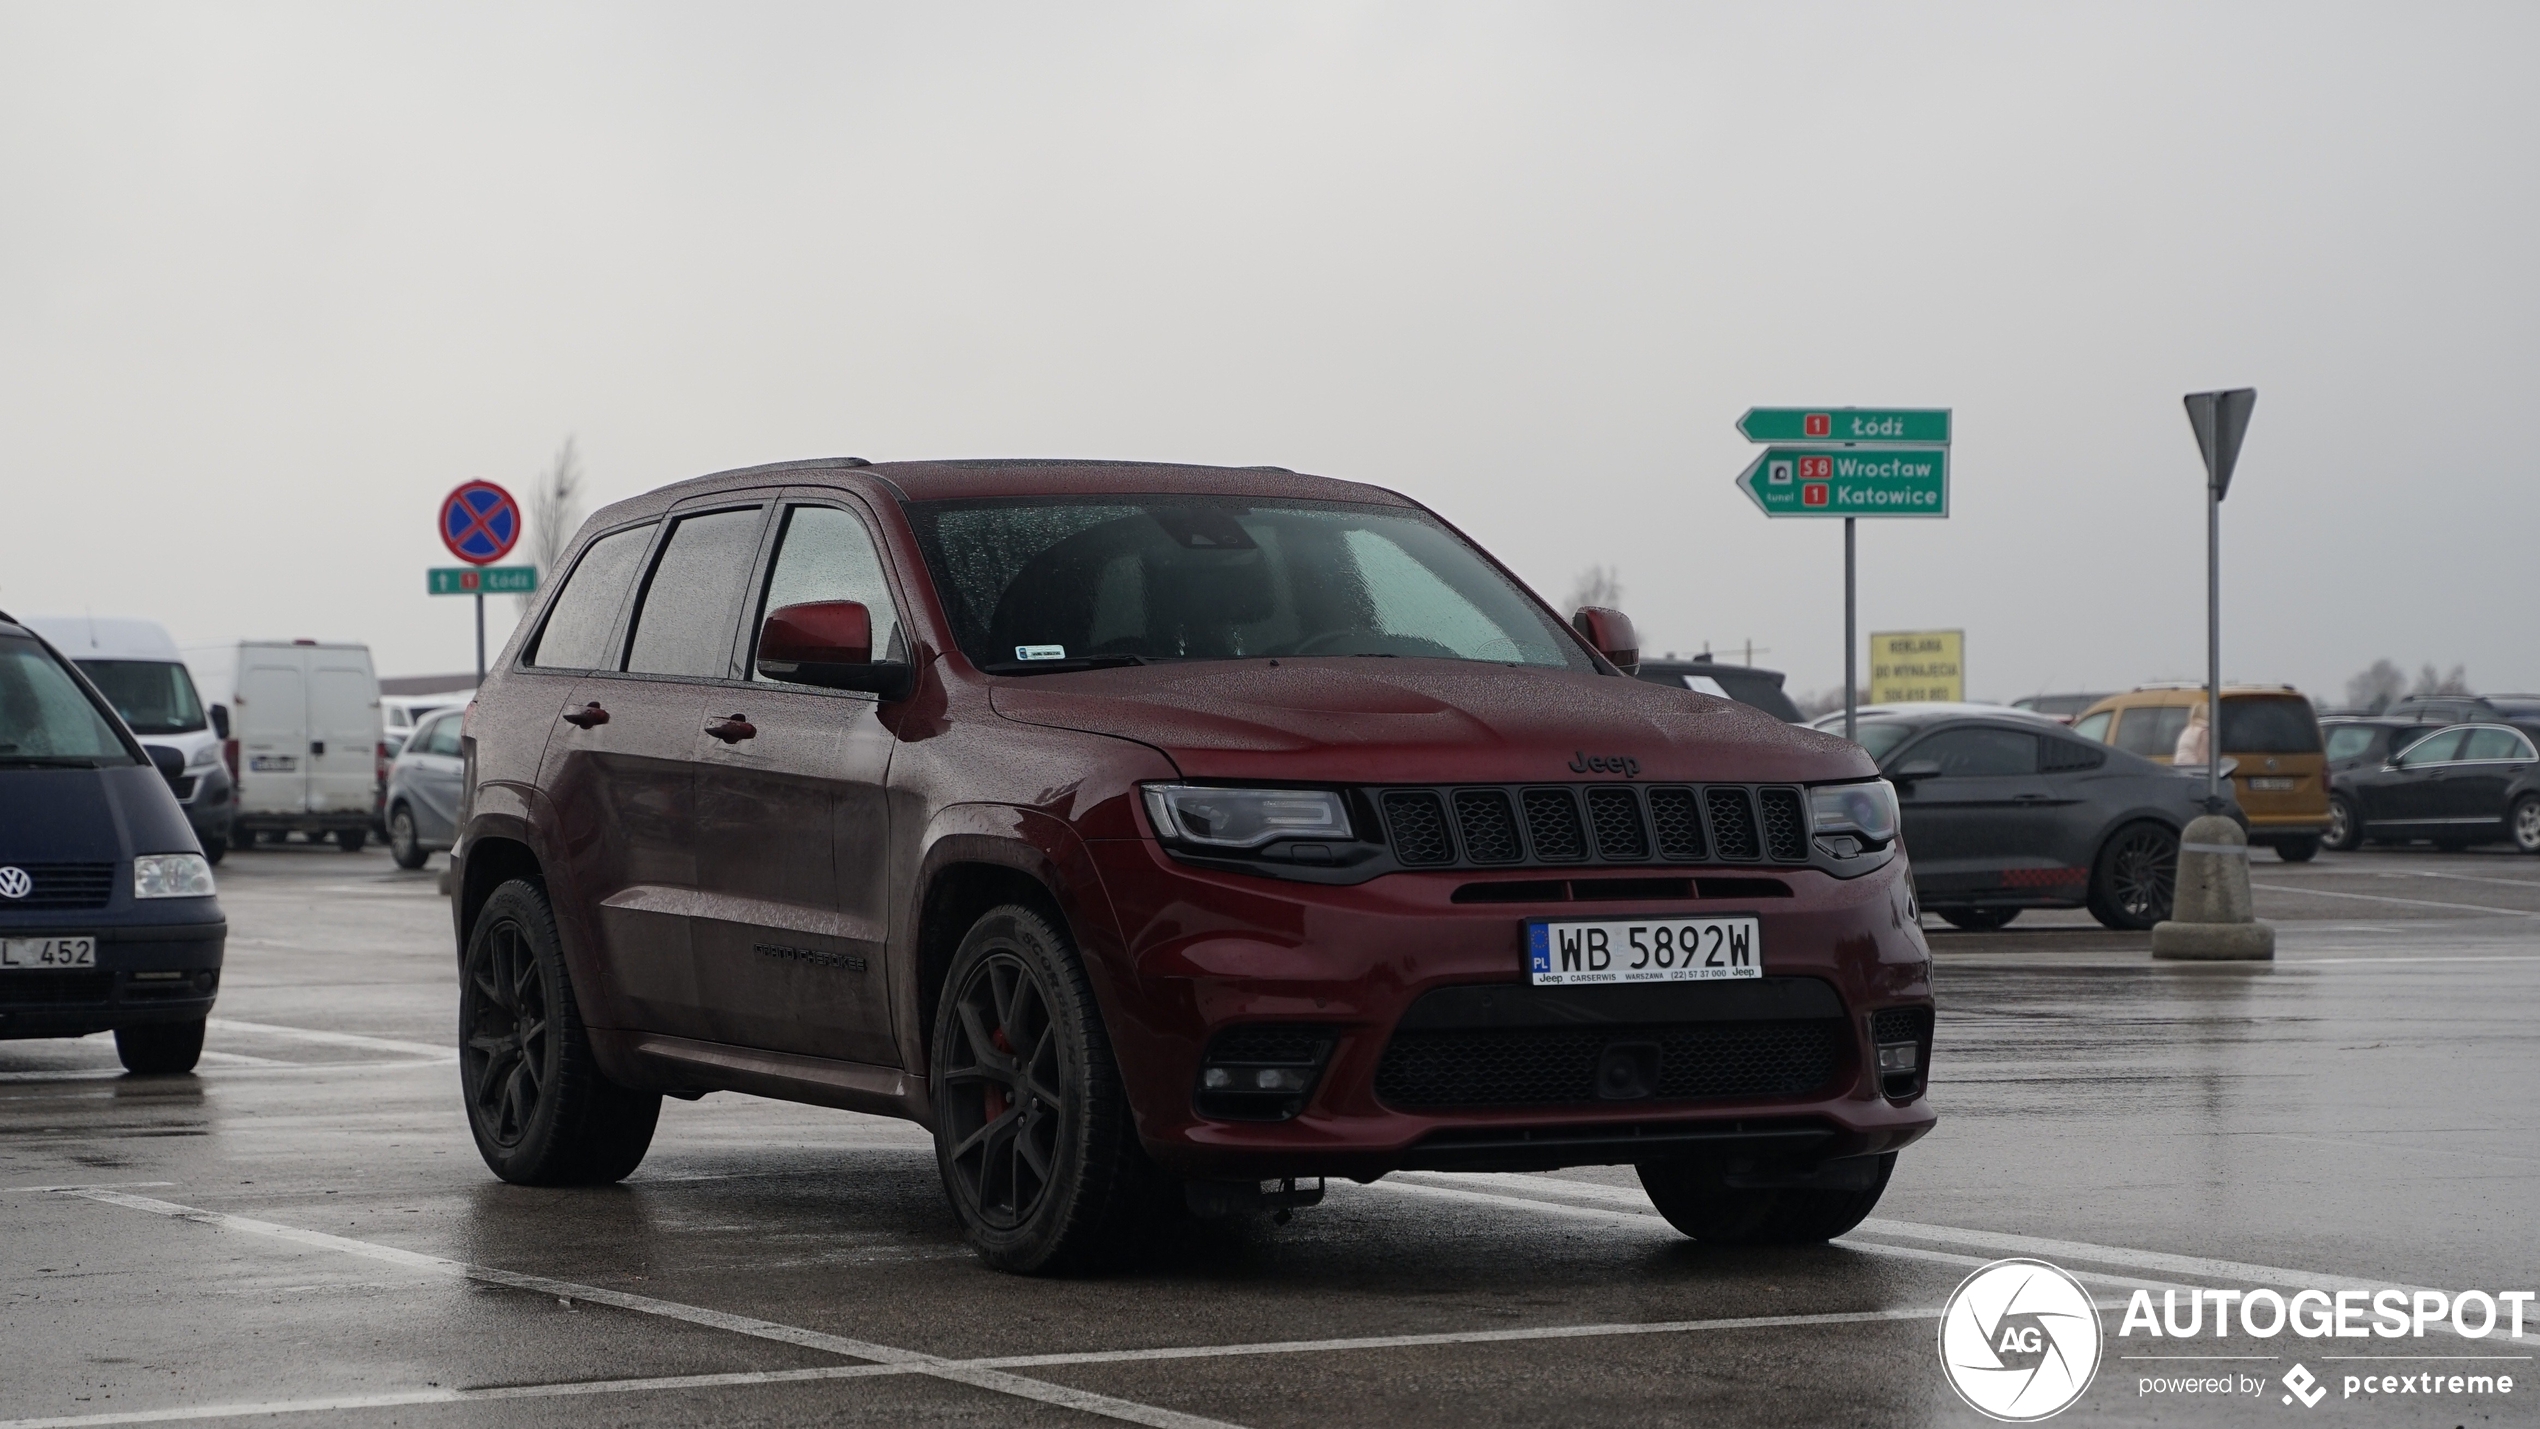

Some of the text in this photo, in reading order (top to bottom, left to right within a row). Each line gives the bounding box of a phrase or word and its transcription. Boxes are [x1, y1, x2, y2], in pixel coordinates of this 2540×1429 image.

[1813, 416, 1904, 436] 1 Łódź
[1837, 458, 1931, 477] Wrocław
[1811, 485, 1938, 505] 1 Katowice
[1568, 750, 1640, 778] Jeep
[41, 940, 90, 965] 452
[754, 942, 867, 972] GRAND CHEROKEE
[1558, 924, 1750, 972] WB 5892W
[1533, 957, 1548, 970] PL
[1539, 967, 1755, 984] Jeep CARSERWIS WARSZAWA (22) 57 37 000 Jeep
